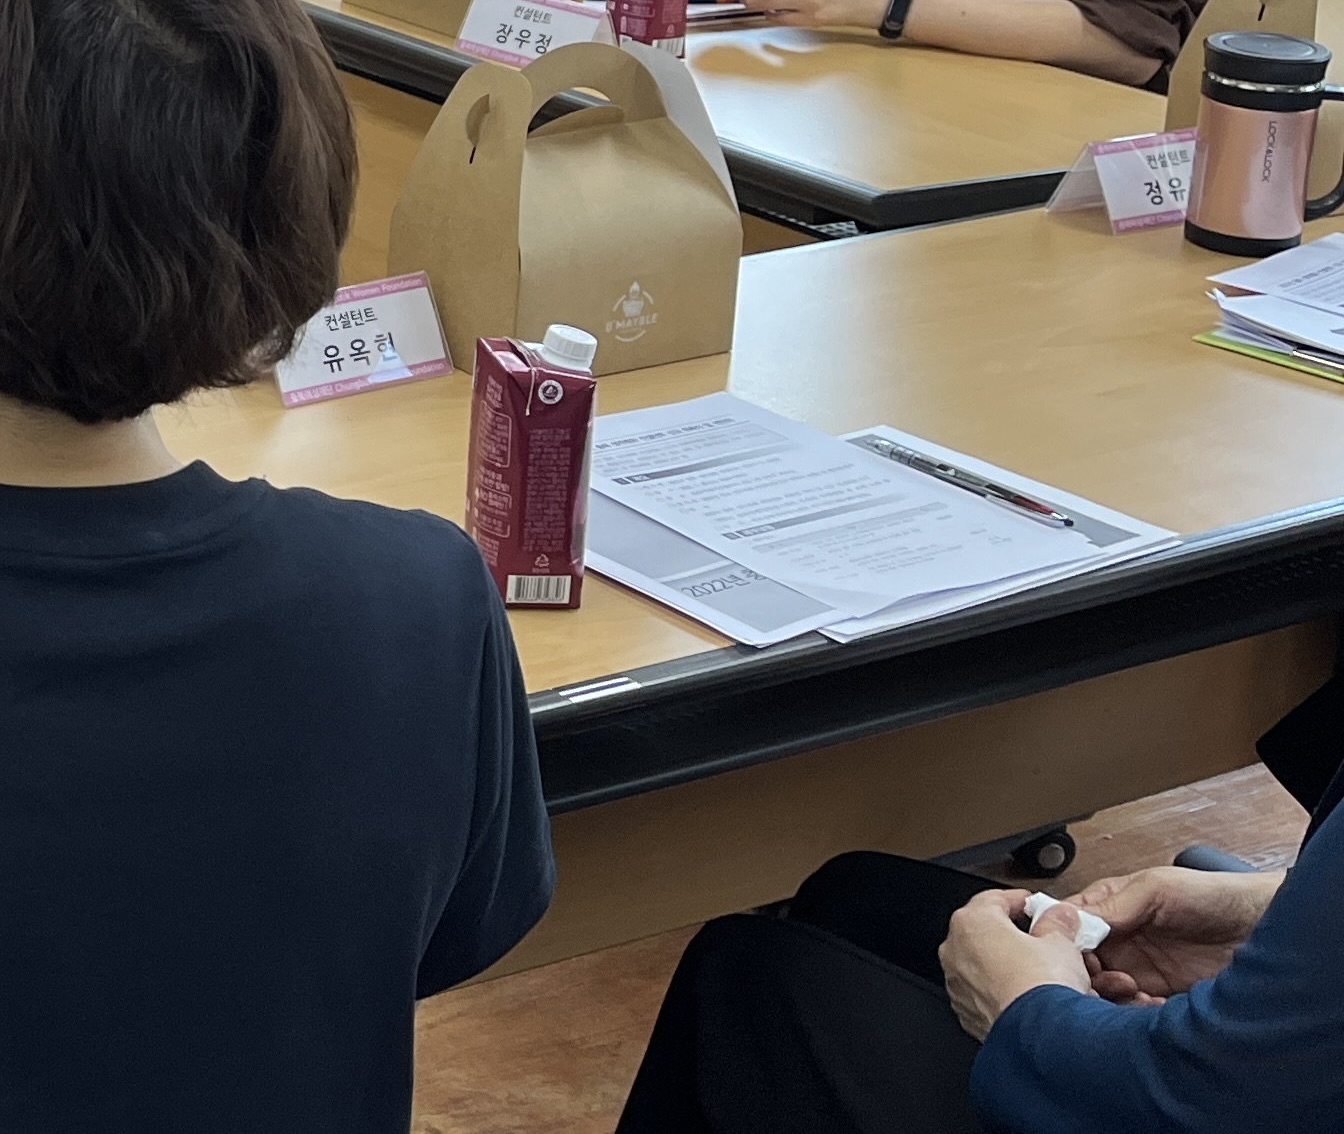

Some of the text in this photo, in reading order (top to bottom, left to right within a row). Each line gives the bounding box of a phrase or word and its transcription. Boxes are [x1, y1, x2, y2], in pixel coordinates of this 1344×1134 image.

[514, 5, 552, 24] 컨설턴트
[496, 23, 552, 54] 장우정
[1146, 150, 1191, 170] 컨설턴트
[1261, 120, 1278, 183] LOCK&LOCK
[1144, 177, 1186, 205] 정유
[324, 307, 378, 332] 컨설턴트
[323, 332, 398, 373] 유옥현
[681, 574, 751, 597] 2022년
